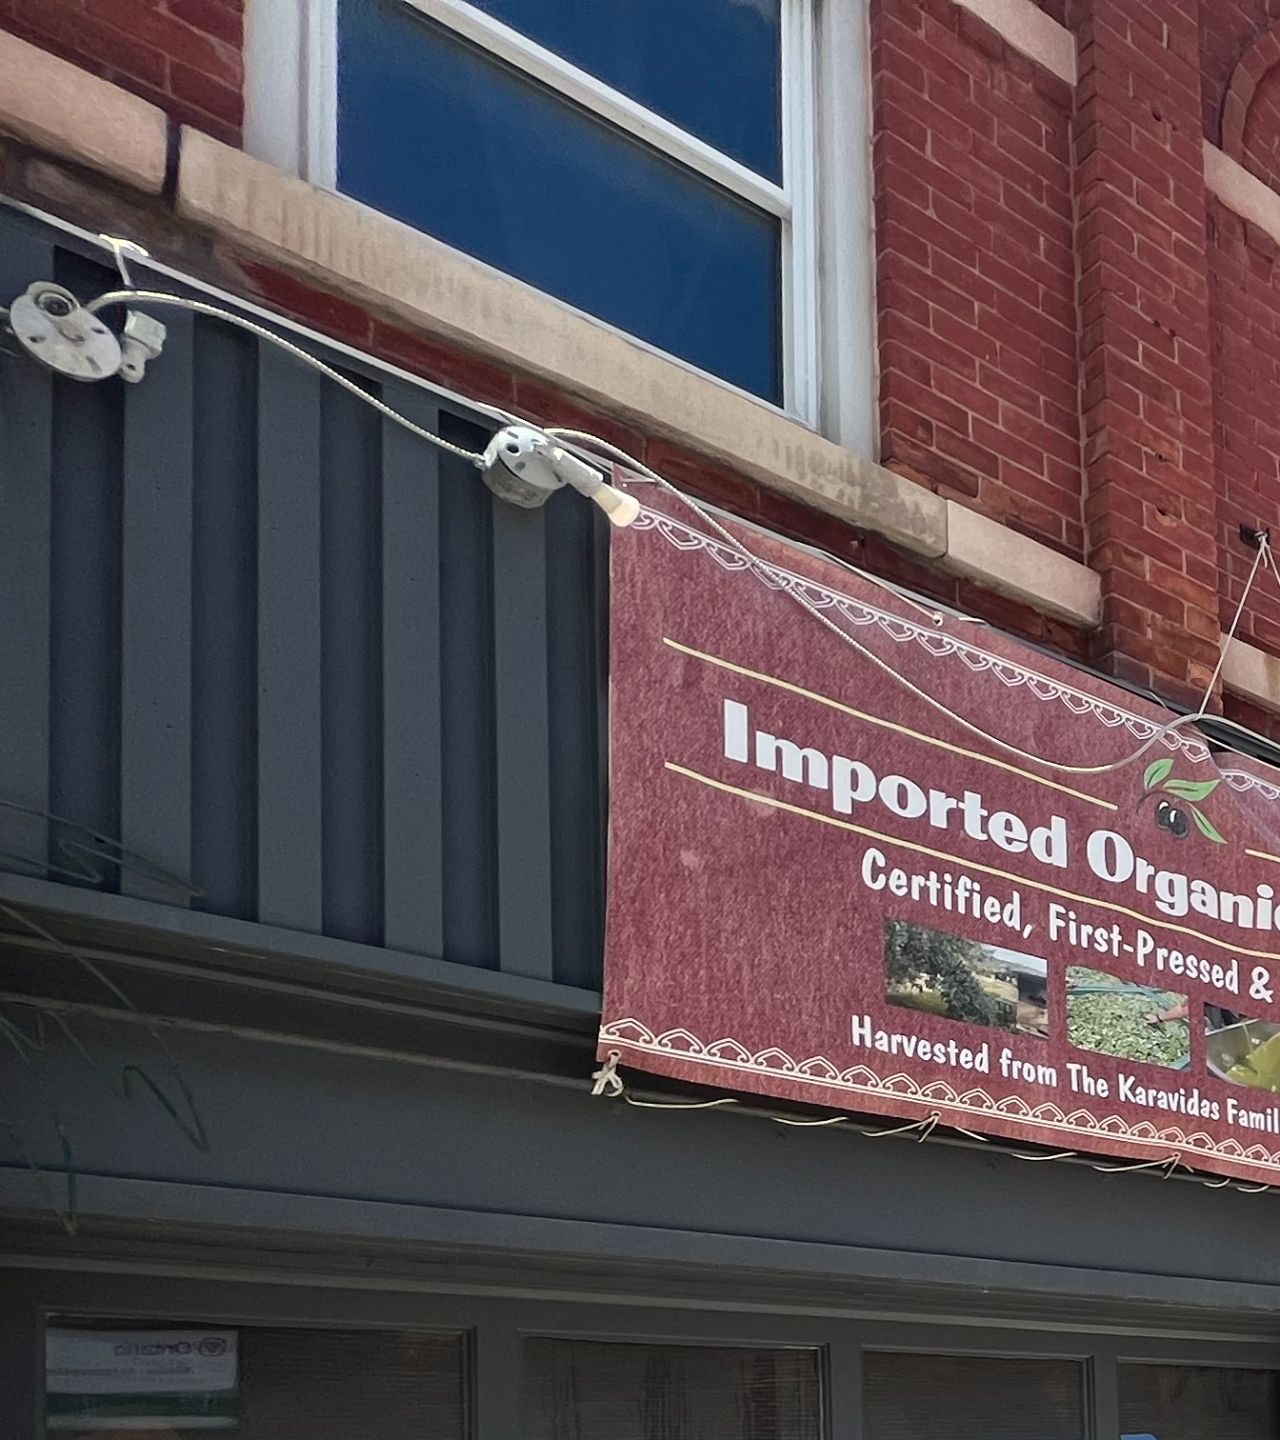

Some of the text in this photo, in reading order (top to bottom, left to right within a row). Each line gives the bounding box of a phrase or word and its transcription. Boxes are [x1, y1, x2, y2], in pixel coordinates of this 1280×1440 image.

[723, 697, 1068, 869] Imported
[861, 847, 1034, 939] Certified,
[1048, 903, 1239, 995] First-Pressed
[1248, 965, 1275, 1004] &
[850, 1014, 989, 1074] Harvested
[999, 1048, 1057, 1088] from
[1065, 1062, 1109, 1098] The
[1117, 1073, 1221, 1121] Karavidas
